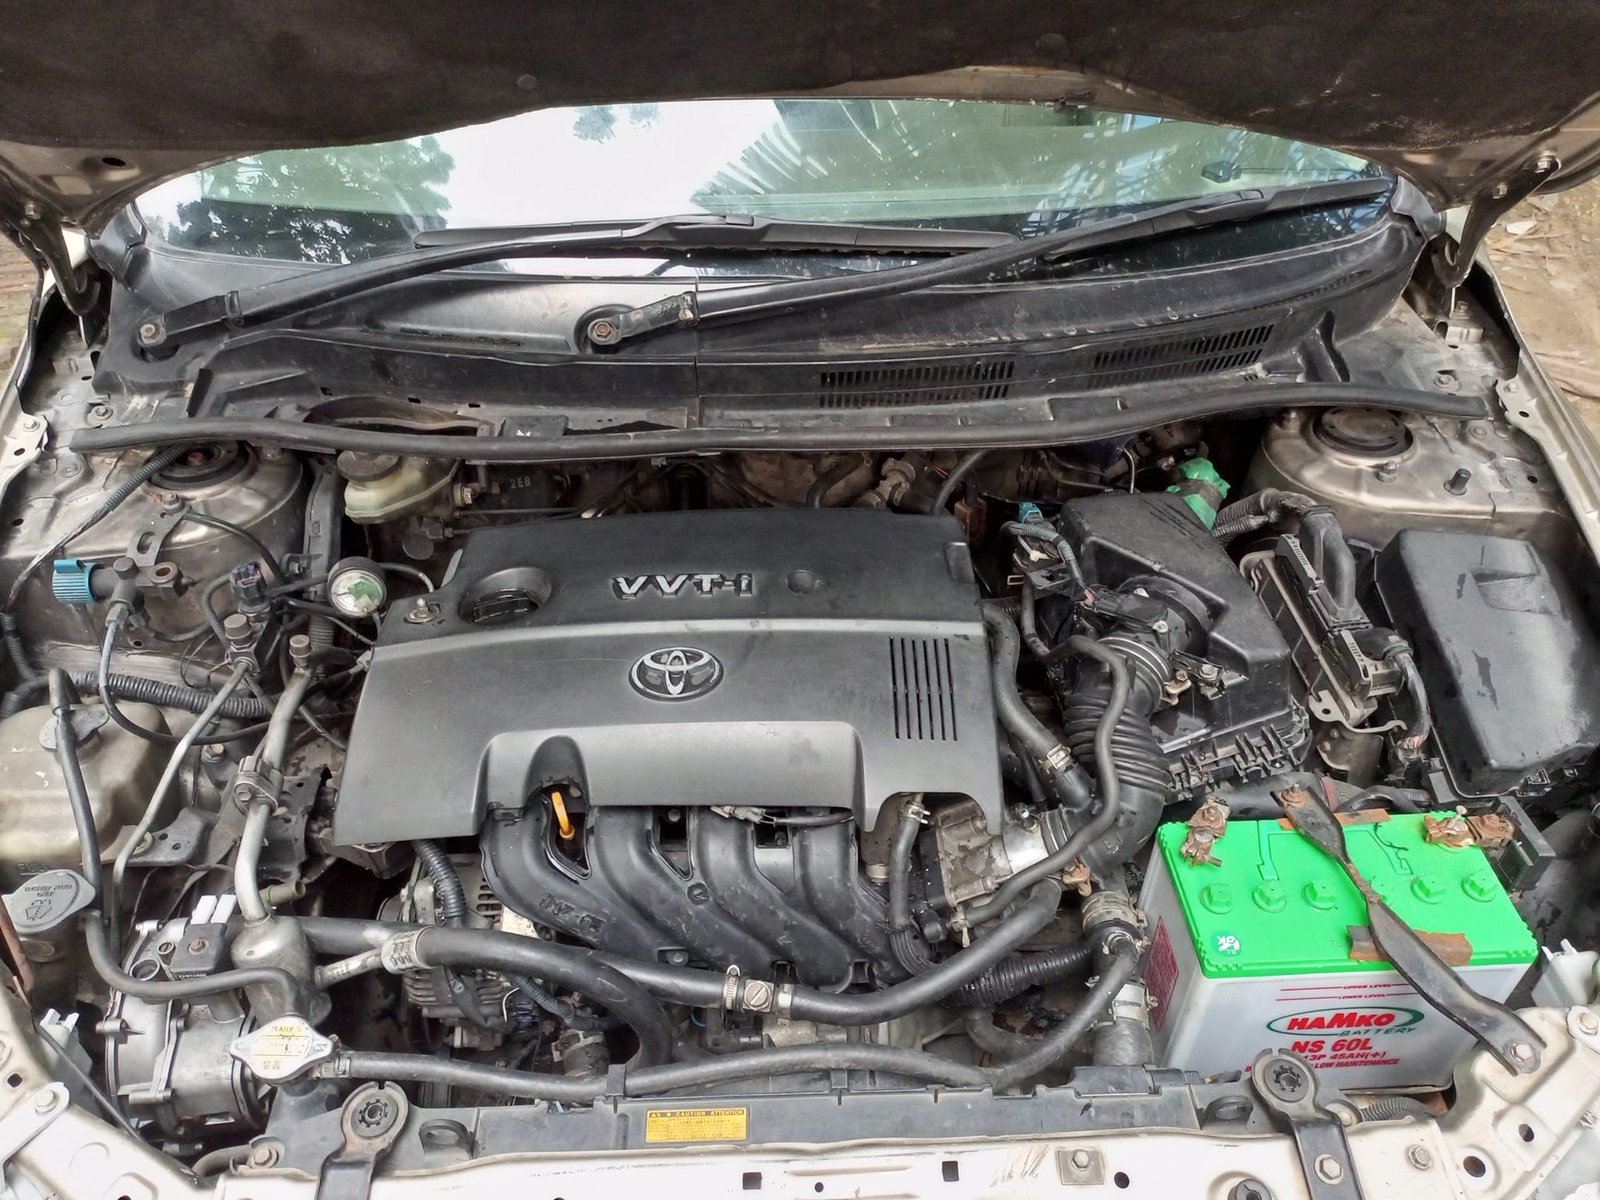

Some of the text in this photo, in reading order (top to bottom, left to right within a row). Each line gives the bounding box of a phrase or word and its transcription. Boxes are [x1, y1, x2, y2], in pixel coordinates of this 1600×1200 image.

[1287, 1012, 1396, 1031] HAMKO
[1339, 1027, 1416, 1037] BATTERY
[1291, 1037, 1373, 1053] NS 60L
[1314, 1058, 1400, 1069] LOW MAINTENANCE
